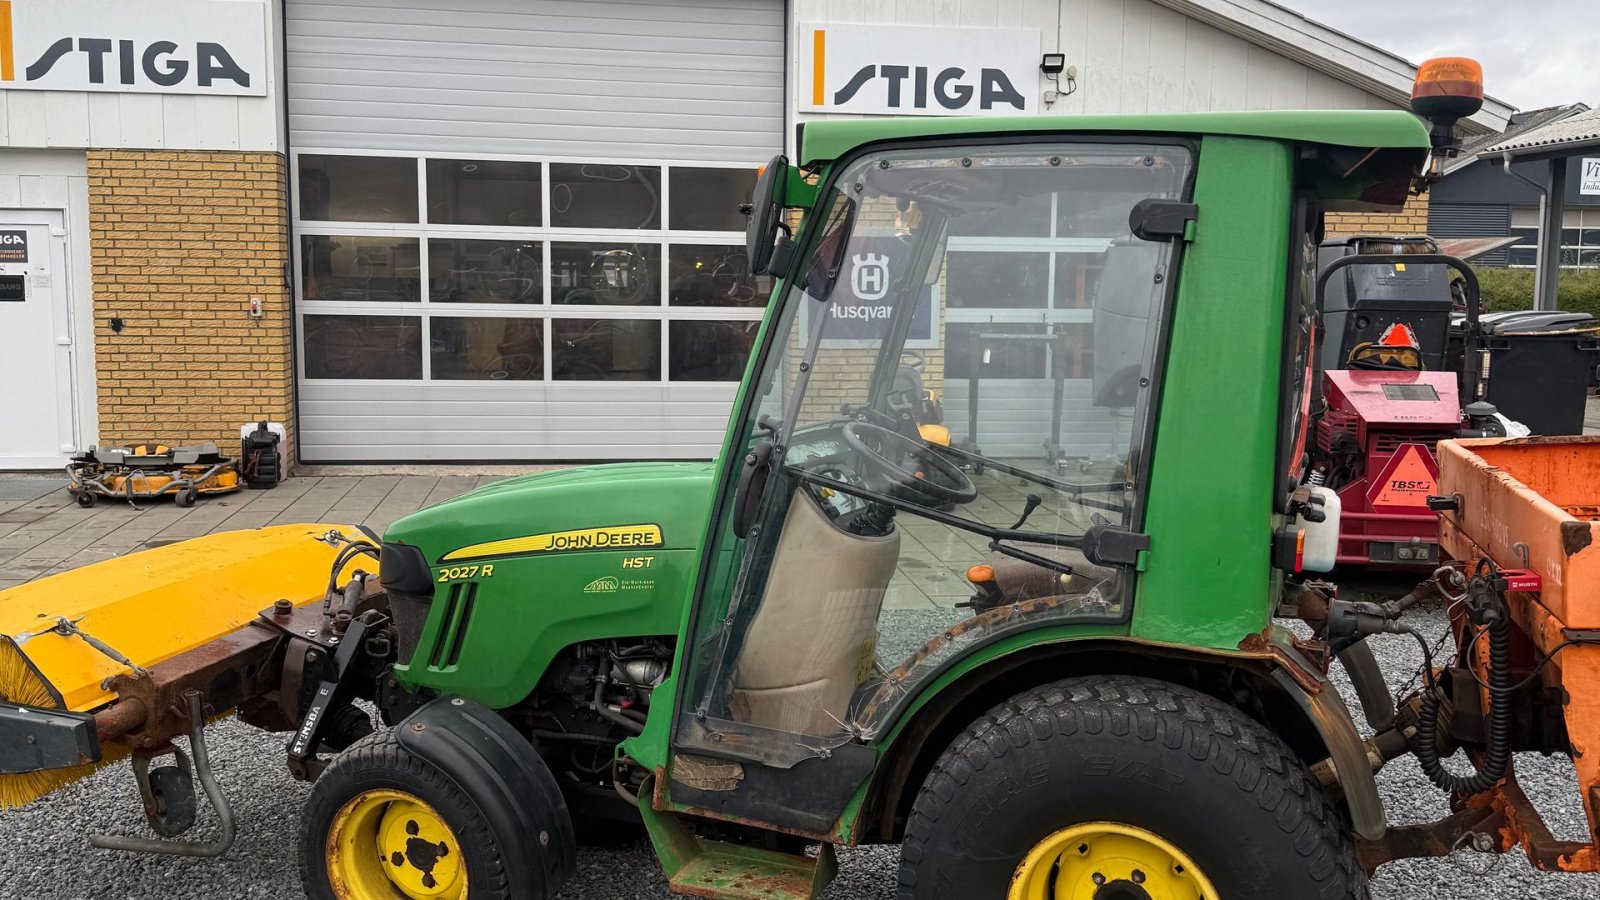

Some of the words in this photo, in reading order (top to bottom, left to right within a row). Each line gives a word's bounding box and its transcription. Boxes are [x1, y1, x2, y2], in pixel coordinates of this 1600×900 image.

[26, 37, 250, 88] STIGA
[834, 64, 1025, 111] STIGA
[1391, 480, 1416, 489] TBS
[546, 534, 591, 550] JOHN
[596, 532, 655, 547] DEERE
[622, 556, 655, 569] HST
[437, 566, 479, 583] 2027
[481, 564, 494, 577] R
